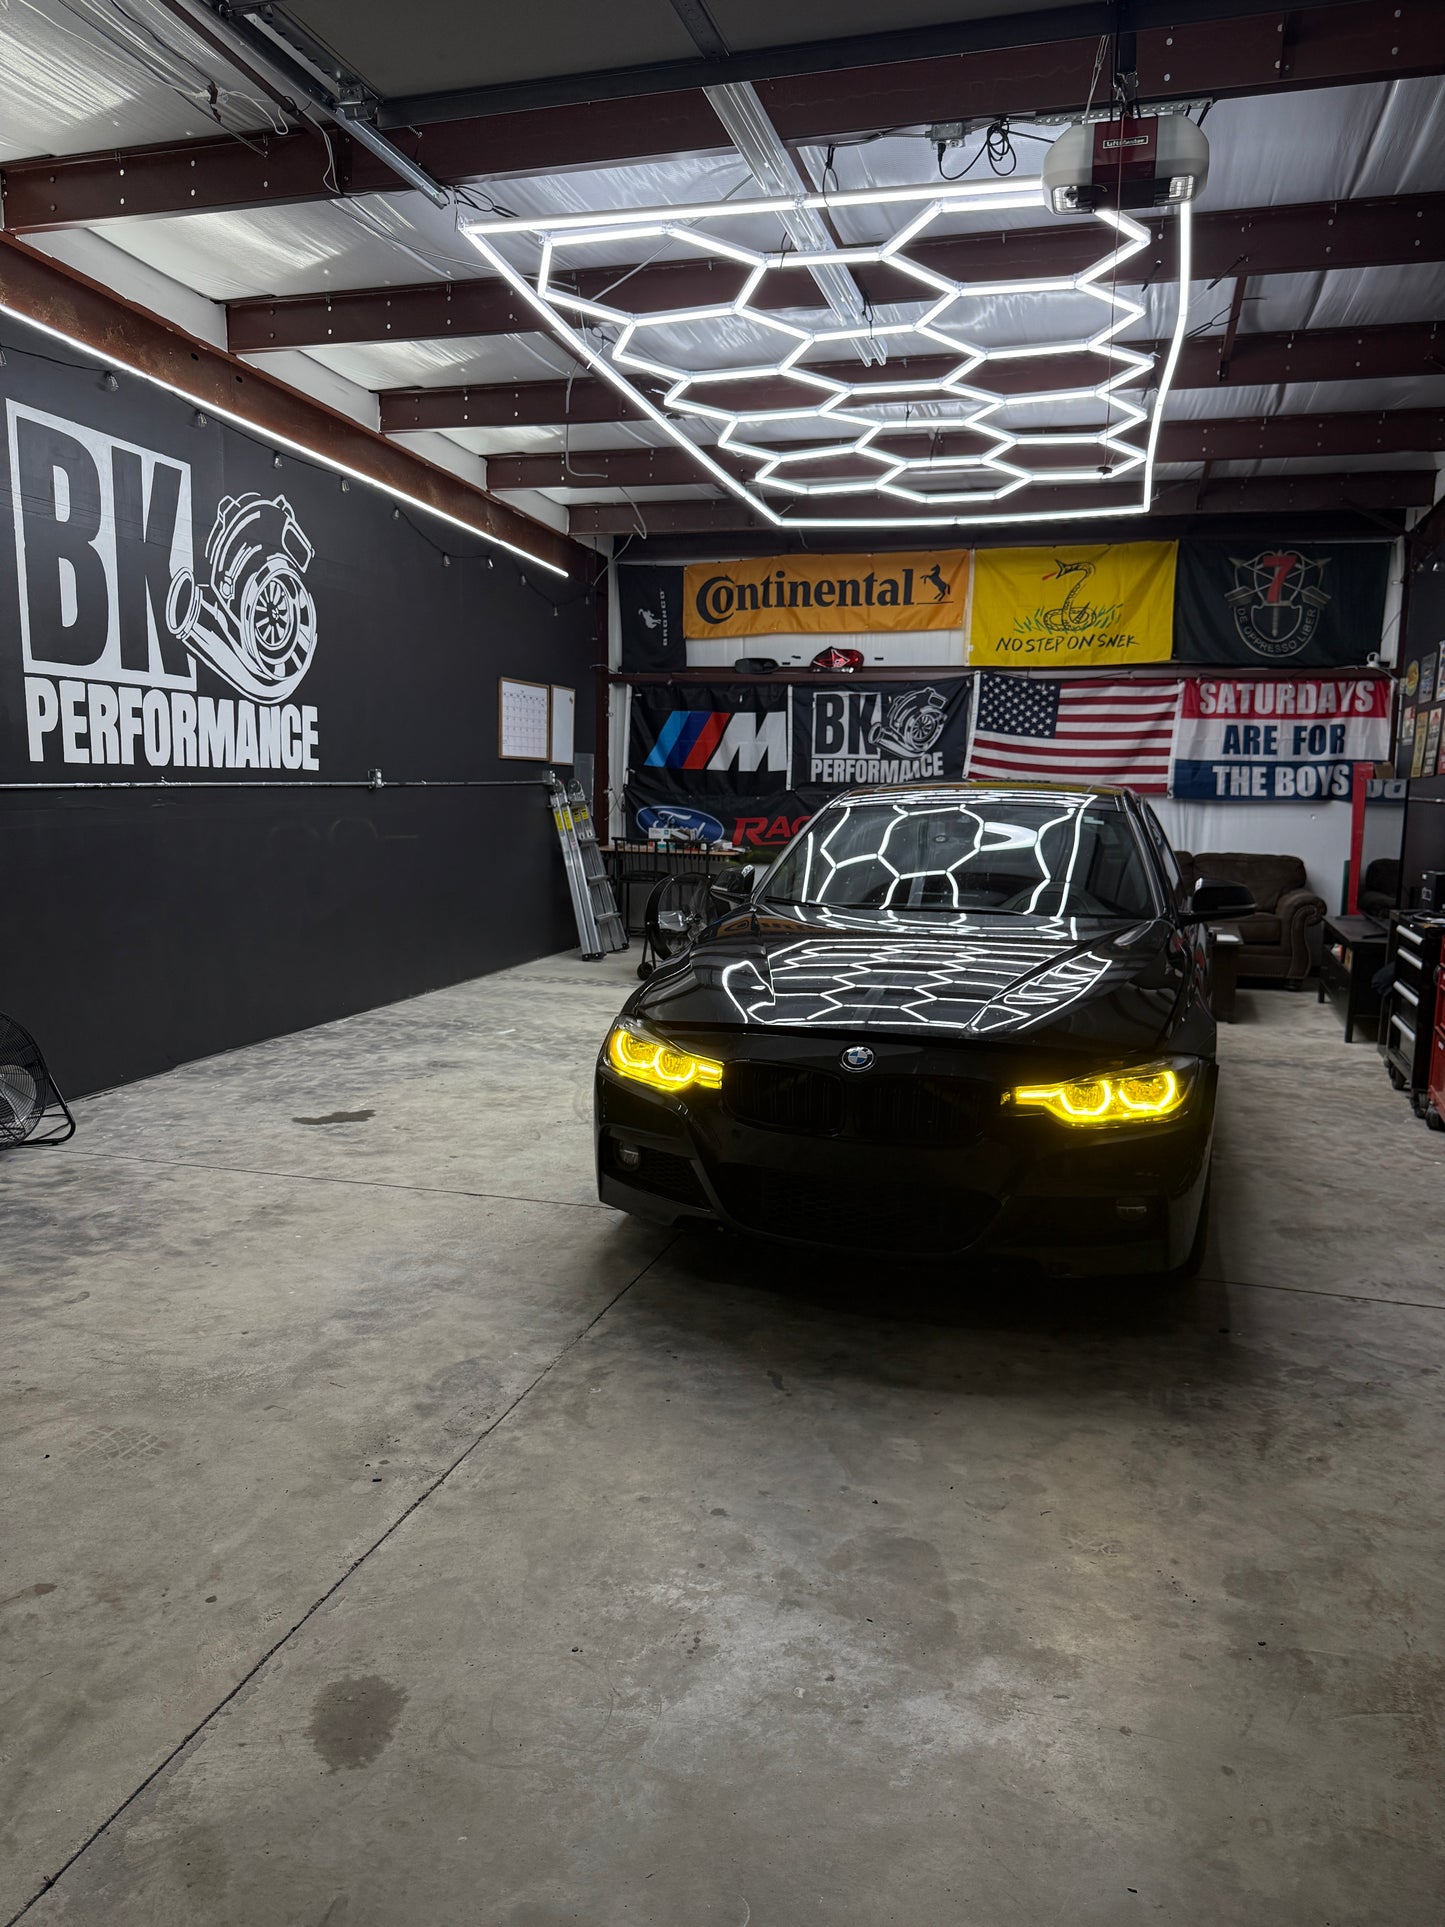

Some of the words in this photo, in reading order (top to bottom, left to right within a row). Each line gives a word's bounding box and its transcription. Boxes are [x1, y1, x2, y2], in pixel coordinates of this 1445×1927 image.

[14, 412, 186, 682] BK
[1263, 555, 1297, 602] 7
[696, 568, 915, 625] Continental
[1237, 607, 1248, 624] DE
[1297, 608, 1316, 642] LIBER
[995, 637, 1023, 652] NO
[1025, 635, 1065, 653] STEP
[1067, 633, 1095, 650] ON
[1097, 633, 1140, 648] SNEK
[1200, 681, 1375, 715] SATURDAYS
[25, 676, 319, 771] PERFORMANCE
[814, 693, 878, 755] BK
[1222, 724, 1277, 756] ARE
[1293, 724, 1346, 756] FOR
[811, 751, 945, 784] PERFORMANCE
[1212, 765, 1267, 797] THE
[1274, 763, 1349, 797] BOYS
